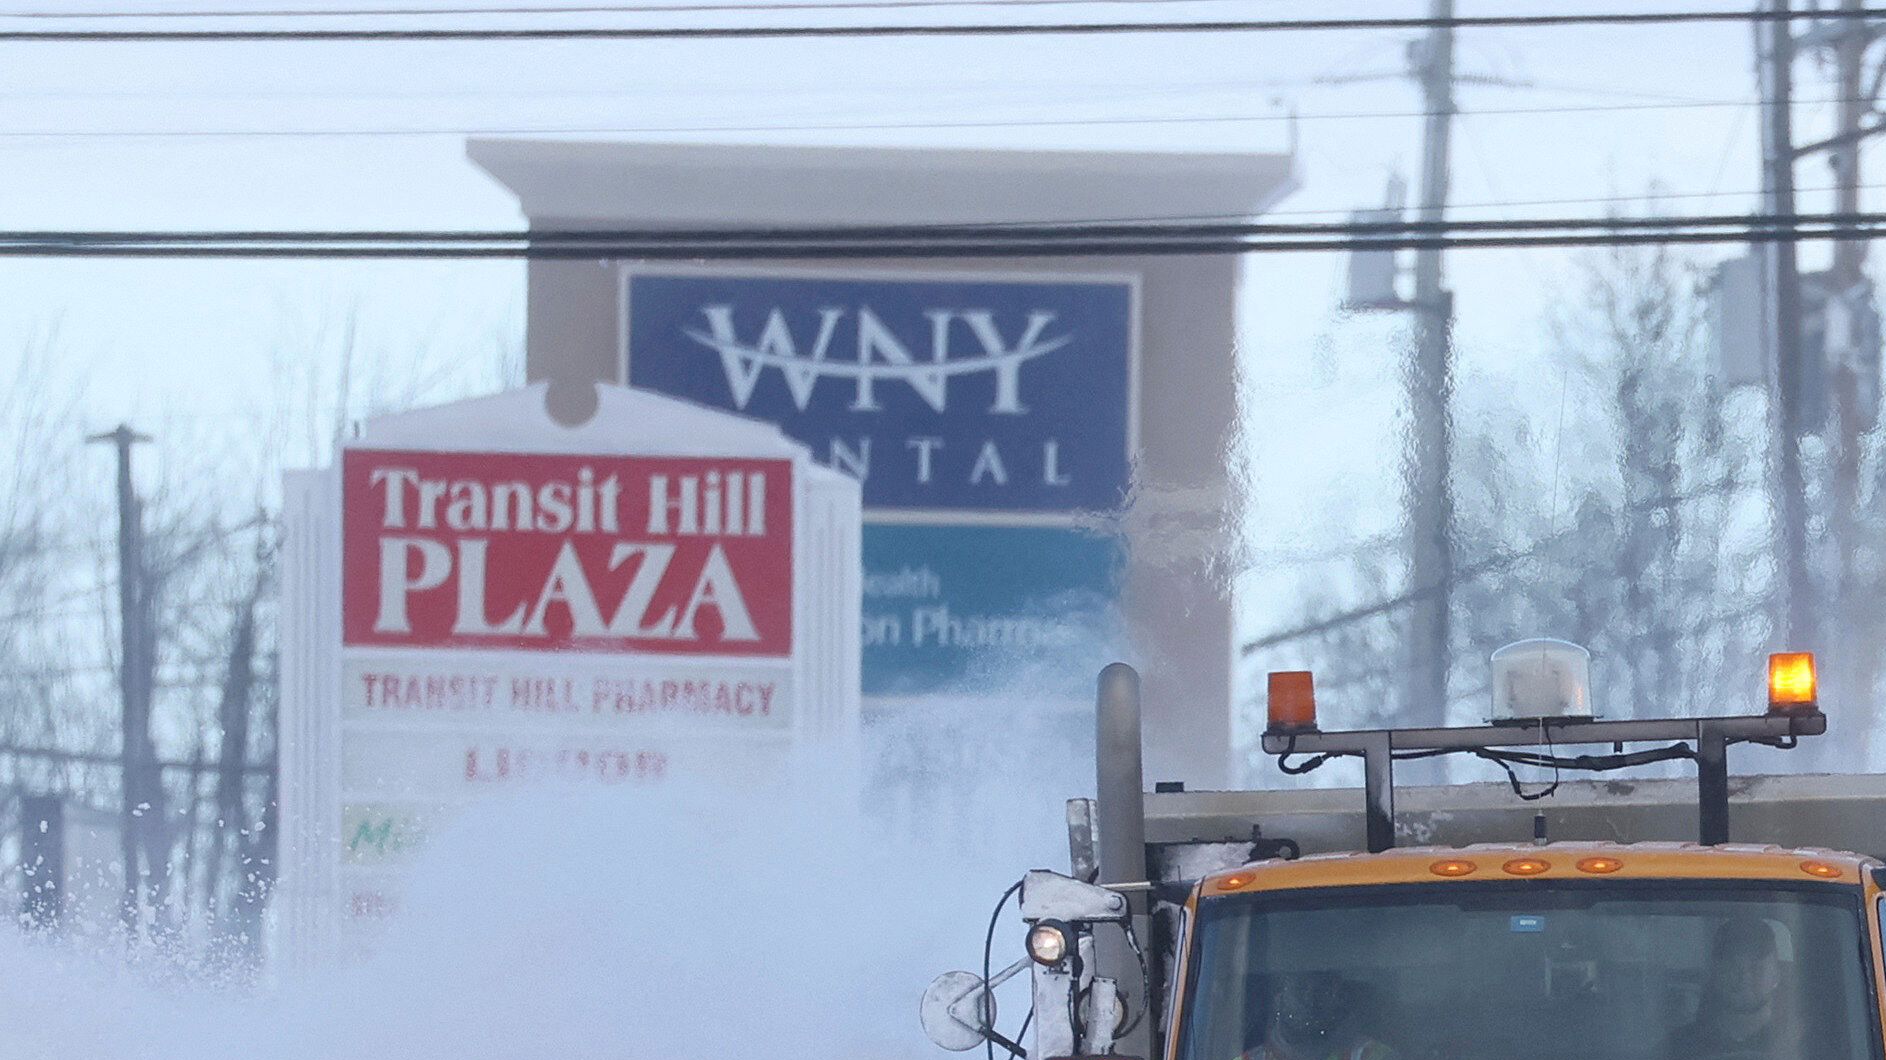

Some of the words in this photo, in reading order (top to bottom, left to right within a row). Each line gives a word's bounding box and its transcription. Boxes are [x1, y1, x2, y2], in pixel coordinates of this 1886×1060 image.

[702, 304, 1057, 414] WNY
[829, 436, 1071, 486] NTAL
[369, 466, 622, 534] Transit
[647, 470, 767, 537] Hill
[372, 536, 762, 643] PLAZA
[362, 672, 499, 711] TRANSIT
[511, 676, 579, 713] HILL
[592, 677, 776, 716] PHARMACY
